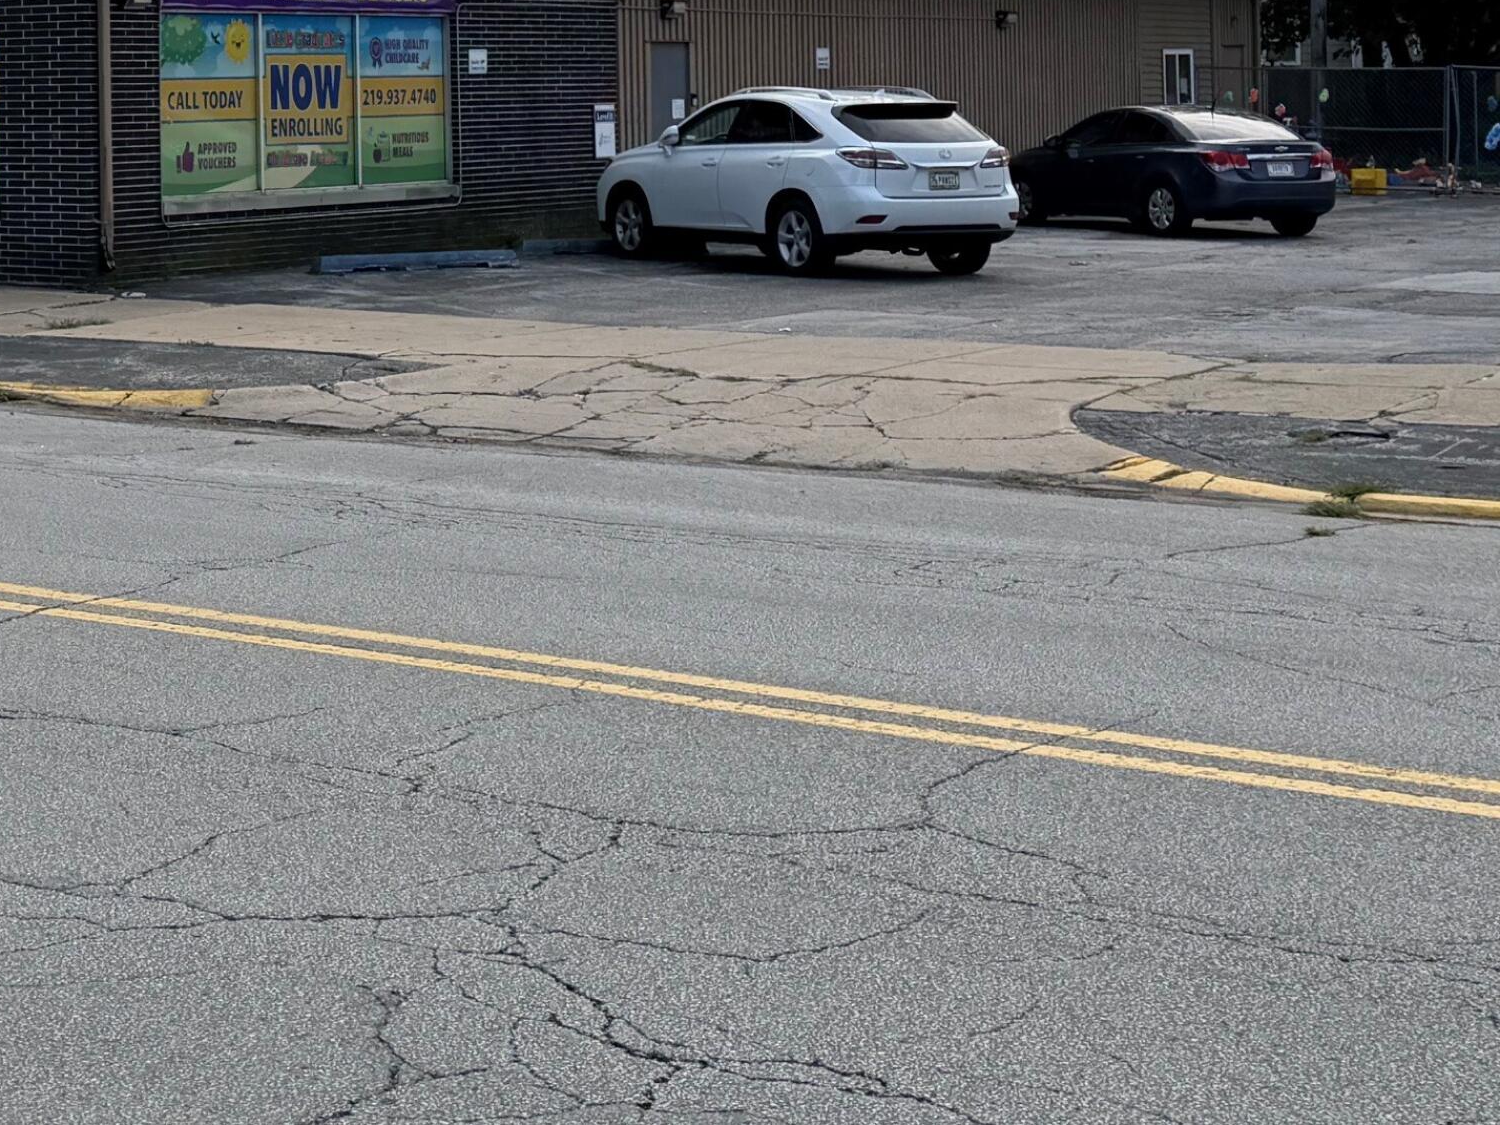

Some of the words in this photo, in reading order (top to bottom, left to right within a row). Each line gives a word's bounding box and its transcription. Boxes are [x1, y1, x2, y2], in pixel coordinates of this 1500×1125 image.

[384, 37, 401, 51] HIGH
[402, 37, 430, 51] QUALITY
[383, 51, 420, 65] CHILDCARE
[270, 63, 341, 111] NOW
[167, 91, 202, 112] CALL
[203, 90, 244, 110] TODAY
[362, 88, 437, 107] 219.937.4740
[270, 117, 344, 138] ENROLLING
[197, 141, 238, 155] APPROVED
[392, 145, 414, 158] MEALS
[197, 155, 237, 171] VOUCHERS
